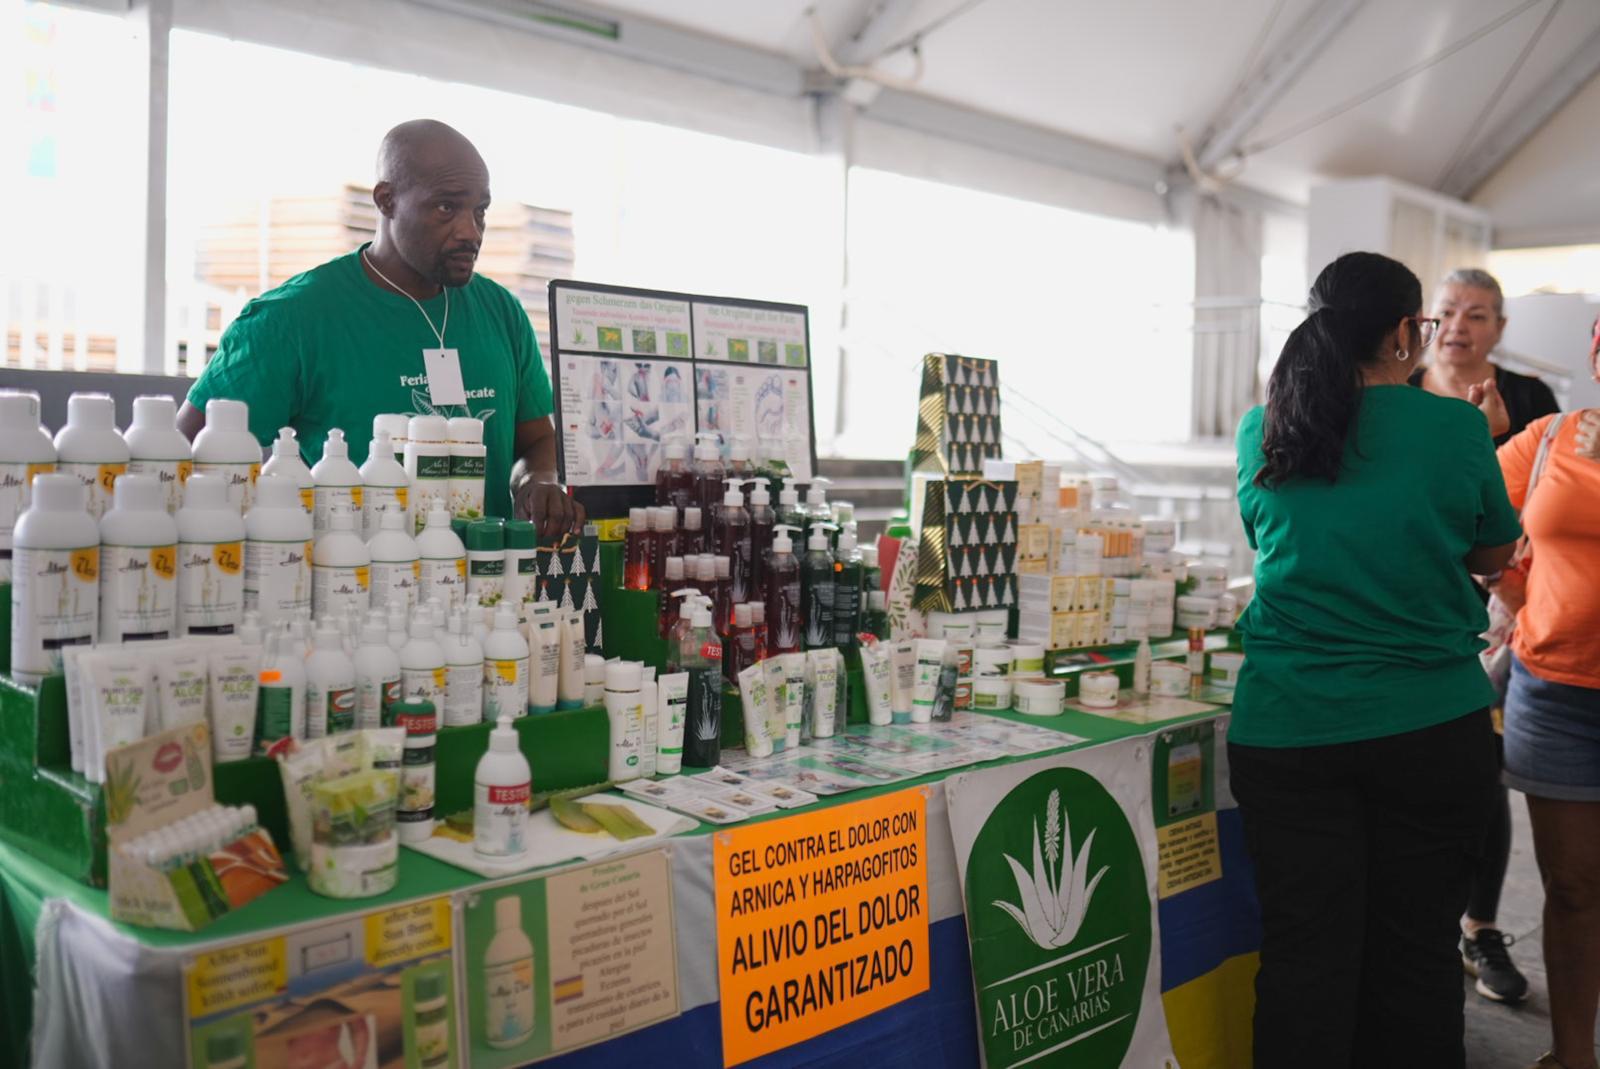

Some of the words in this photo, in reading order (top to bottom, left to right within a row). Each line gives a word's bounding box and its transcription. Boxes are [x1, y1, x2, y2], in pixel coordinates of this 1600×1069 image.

[729, 849, 761, 877] GEL
[765, 834, 826, 868] CONTRA
[829, 830, 845, 853] EL
[849, 818, 890, 849] DOLOR
[892, 810, 917, 836] CON
[731, 878, 796, 917] ARNICA
[799, 873, 809, 899] Y
[813, 843, 918, 896] HARPAGOFITOS
[732, 920, 808, 975] ALIVIO
[815, 907, 853, 950] DEL
[859, 884, 920, 935] DOLOR
[746, 939, 913, 1033] GARANTIZADO
[992, 978, 1059, 1037] ALOE
[1067, 953, 1125, 1000] VERA
[1013, 1024, 1033, 1051] DE
[1038, 992, 1111, 1040] CANARIAS
